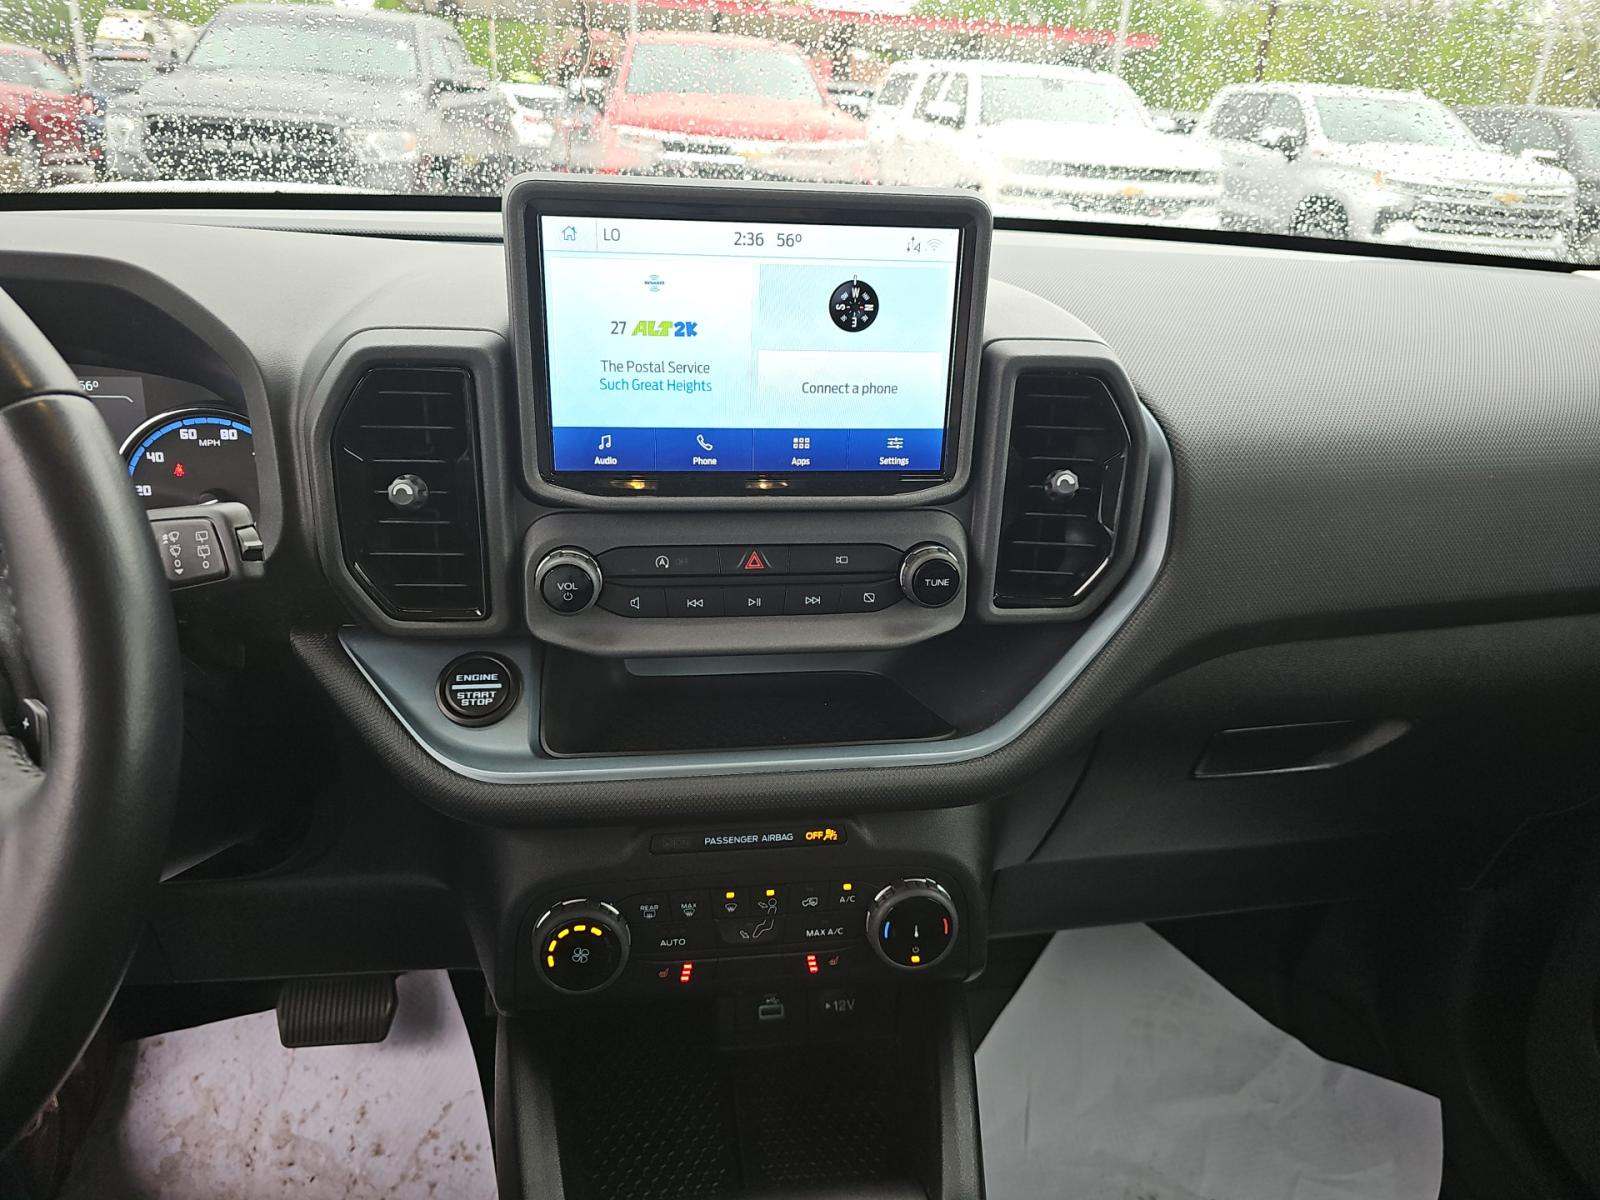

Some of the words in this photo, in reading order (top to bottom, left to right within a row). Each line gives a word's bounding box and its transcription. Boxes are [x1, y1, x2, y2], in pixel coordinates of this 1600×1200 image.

[603, 227, 621, 242] LO
[734, 231, 764, 246] 2:36
[851, 287, 861, 299] W
[610, 321, 627, 335] 27
[600, 360, 624, 373] The
[626, 360, 665, 373] Postal
[667, 361, 711, 374] Service
[599, 378, 629, 391] Such
[631, 379, 665, 391] Great
[667, 379, 713, 394] Heights
[801, 381, 849, 394] Connect
[852, 384, 859, 394] a
[862, 382, 898, 396] phone
[179, 428, 198, 440] 60
[219, 429, 238, 441] 80
[198, 439, 221, 448] MPH
[146, 451, 165, 463] 40
[594, 456, 618, 465] Audio
[692, 456, 718, 465] Phone
[791, 457, 811, 466] Apps
[879, 456, 910, 466] Settings
[557, 582, 579, 591] VOL
[924, 578, 950, 587] TUNE
[455, 673, 499, 682] ENGINE
[456, 690, 497, 699] START
[460, 697, 493, 706] STOP
[704, 834, 759, 845] PASSENGER
[761, 832, 794, 843] AIRBAG
[805, 830, 824, 841] OFF
[839, 895, 856, 903] A/C
[806, 929, 826, 937] MAX
[827, 927, 844, 935] A/C
[660, 938, 686, 947] AUTO
[833, 999, 855, 1012] 12V
